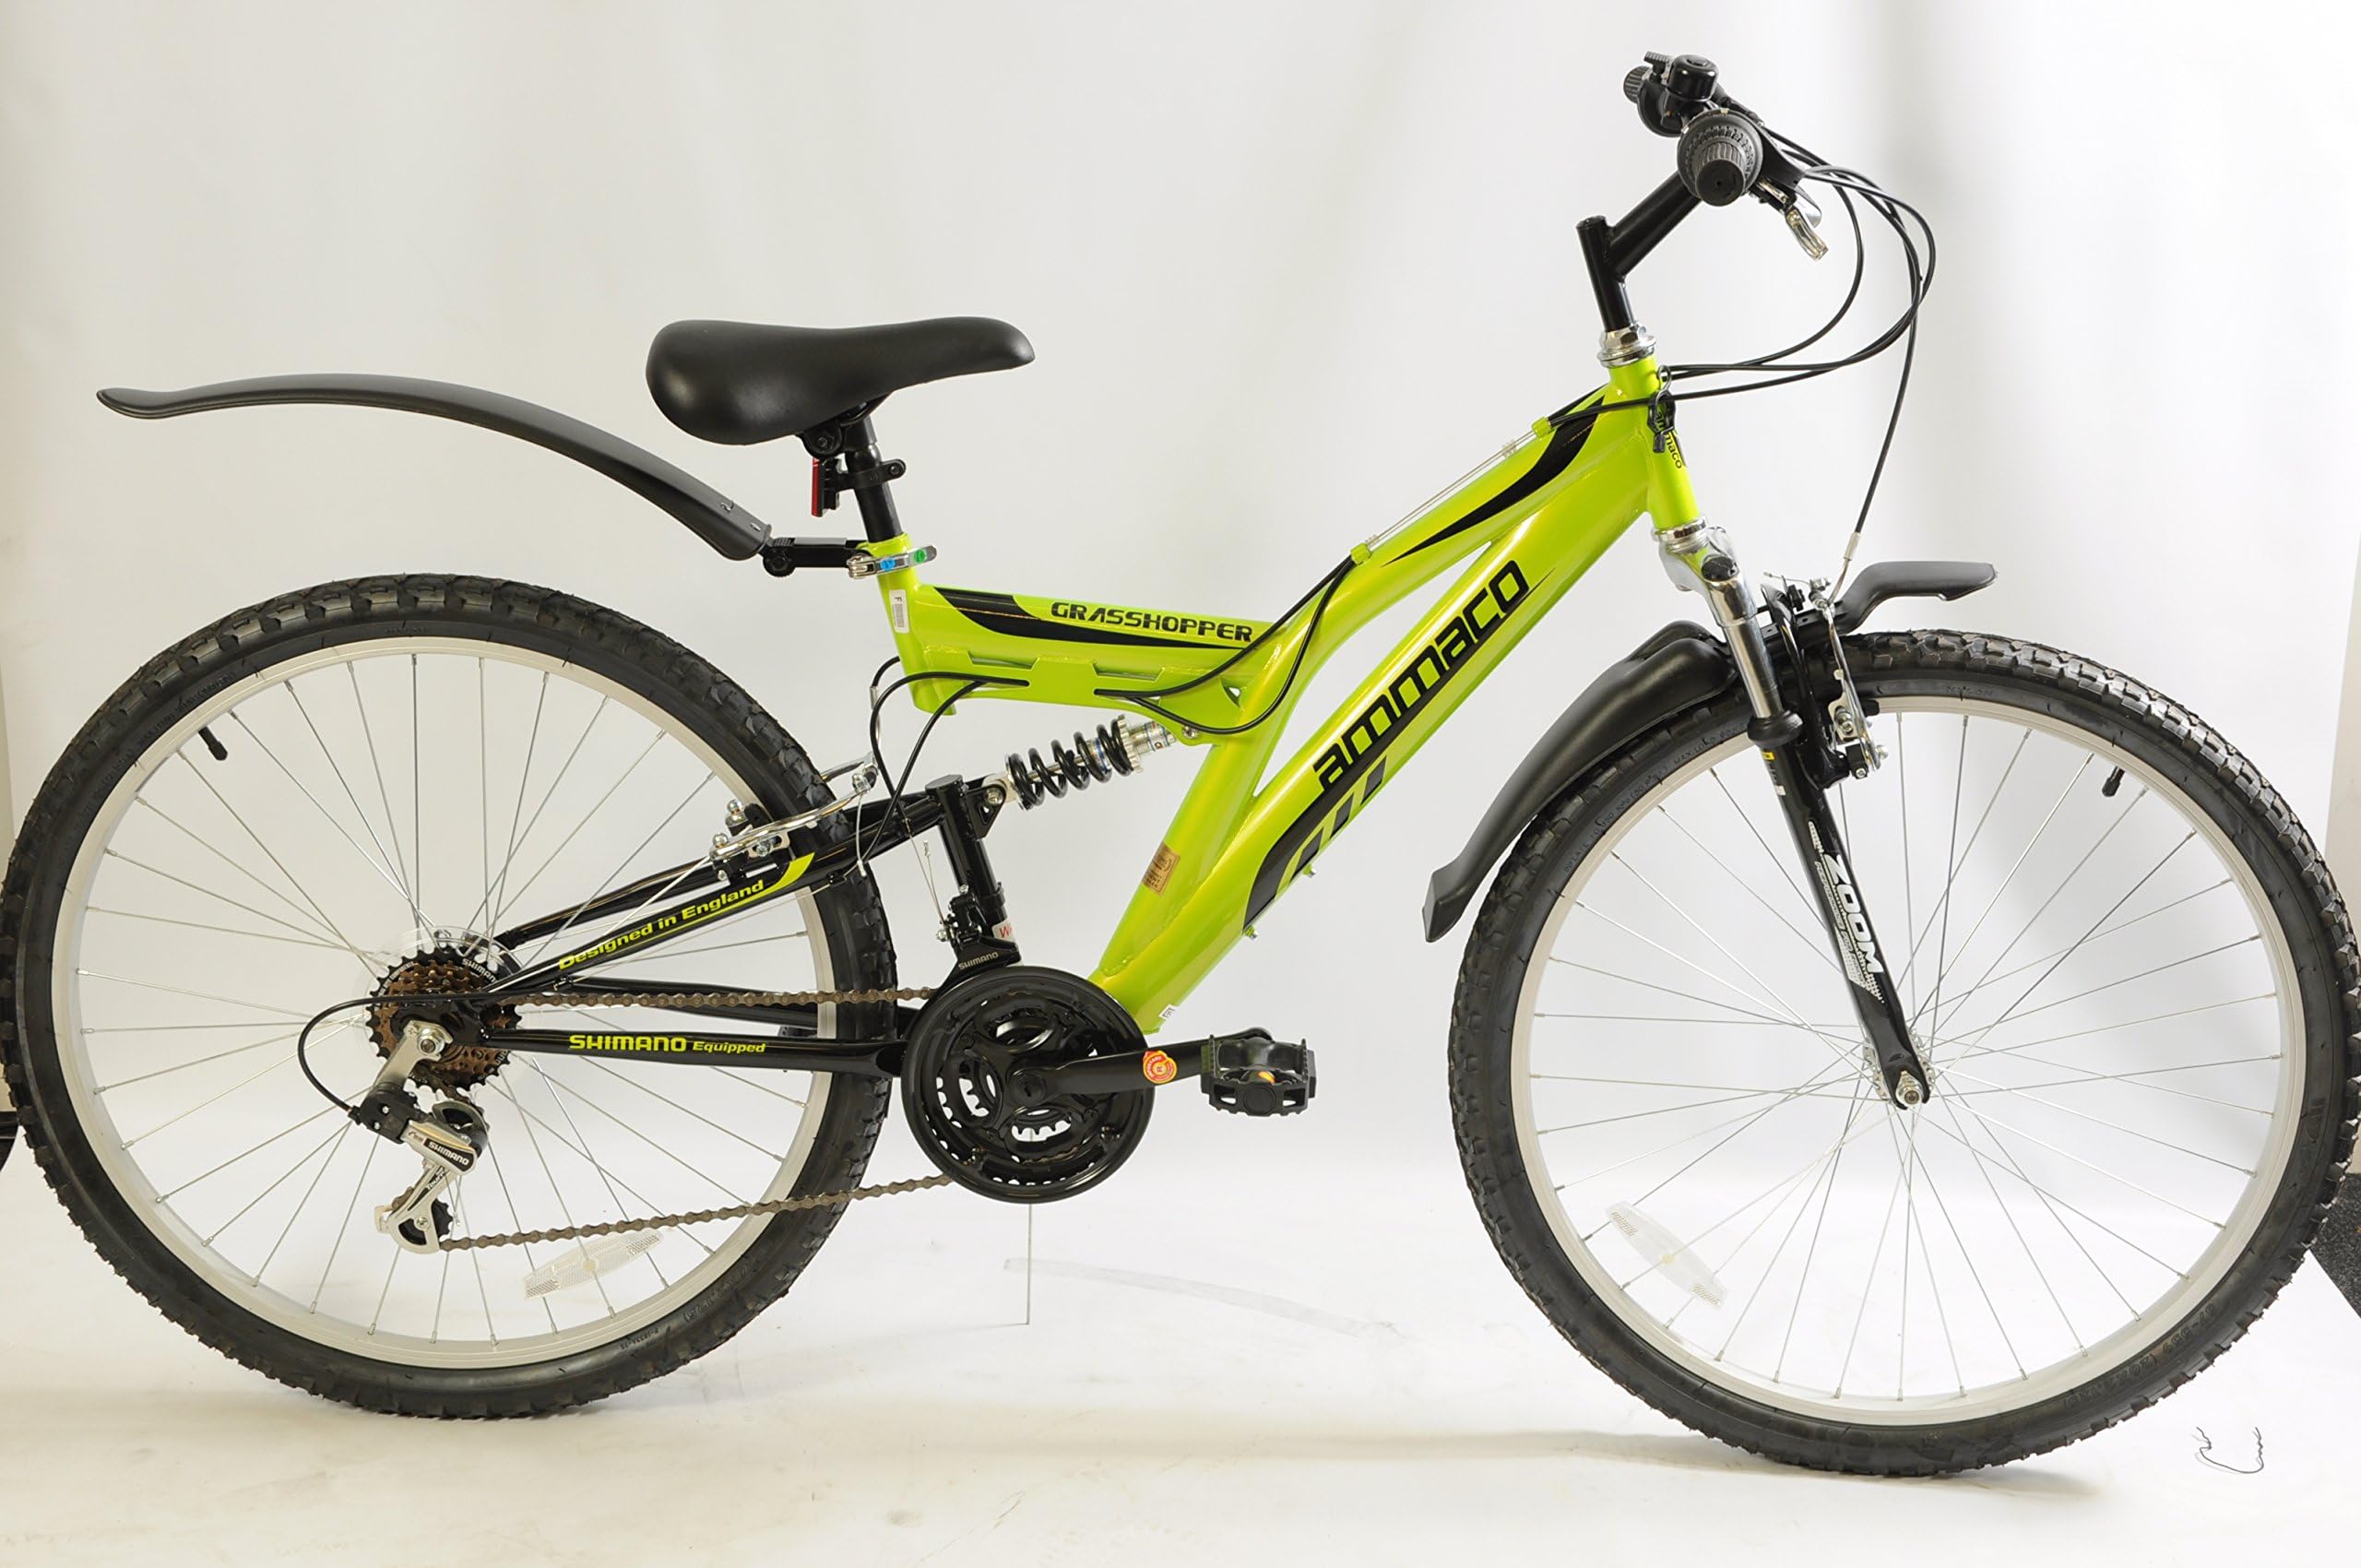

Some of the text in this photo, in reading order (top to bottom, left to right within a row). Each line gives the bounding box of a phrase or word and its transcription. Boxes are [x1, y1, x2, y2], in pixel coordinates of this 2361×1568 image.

[1051, 601, 1253, 643] GRASSHOPPER
[1313, 560, 1530, 791] ammaco
[559, 879, 765, 970] Designed in England
[1823, 854, 1884, 974] ZOOM
[462, 958, 498, 982] SHIMAN
[958, 951, 999, 970] SHIMANO
[569, 1035, 766, 1054] SHIMANO Equipped
[428, 1141, 469, 1166] SHIMANO
